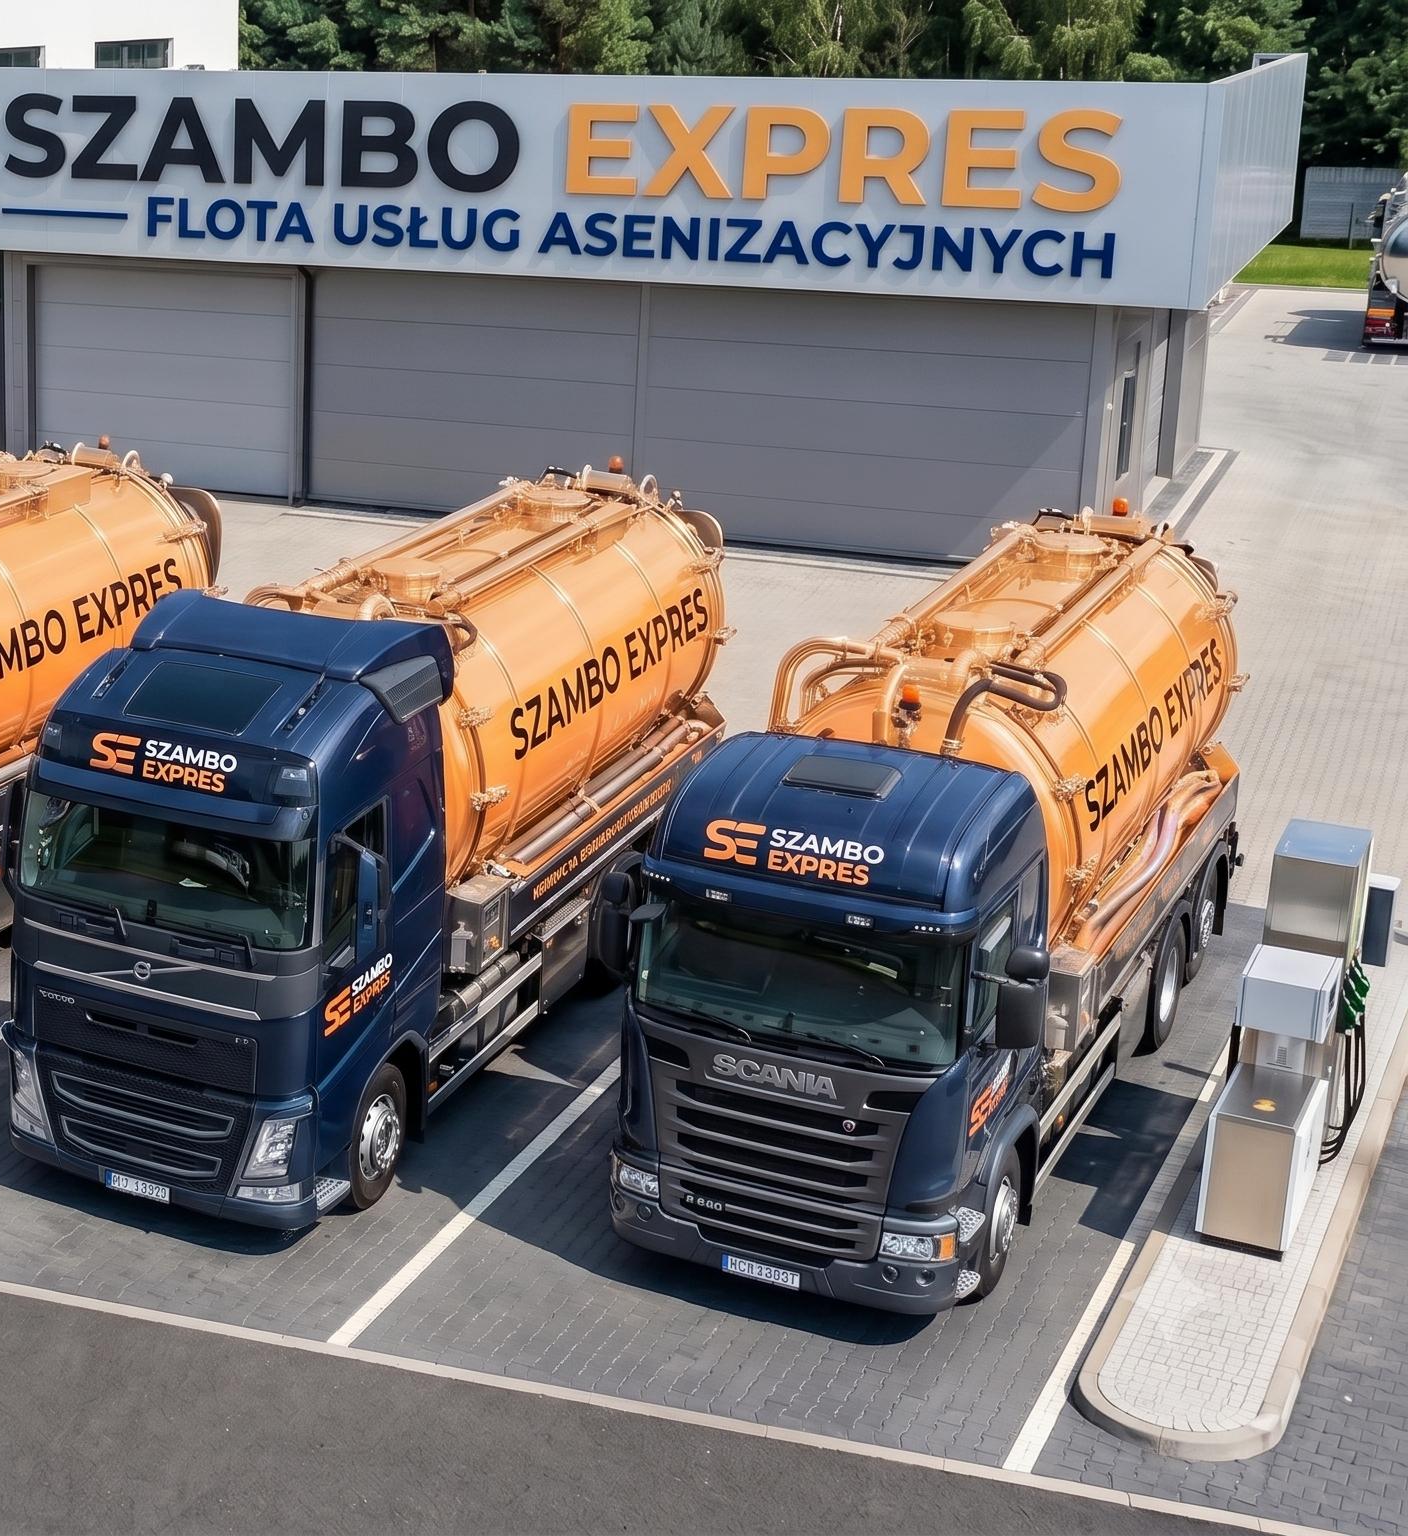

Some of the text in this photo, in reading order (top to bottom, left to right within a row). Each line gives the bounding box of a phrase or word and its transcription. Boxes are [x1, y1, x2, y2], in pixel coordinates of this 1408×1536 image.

[4, 92, 1123, 213] SZAMBO EXPRES
[146, 196, 1117, 280] FLOTA USŁUG ASENIZACYJNYCH
[510, 588, 709, 760] SZAMBO EXPRES
[89, 732, 142, 775] SE
[145, 739, 237, 773] SZAMBO
[1085, 706, 1164, 832] SZAMBO
[1164, 638, 1222, 738] EXPRES
[142, 759, 225, 793] EXPRES
[703, 819, 767, 866] SE
[769, 828, 885, 865] SZAMBO
[767, 849, 869, 886] EXPRES
[351, 953, 393, 997] SZAMBO
[353, 970, 391, 1014] EXPRES
[324, 986, 351, 1037] SE
[712, 1053, 837, 1100] SCANIA
